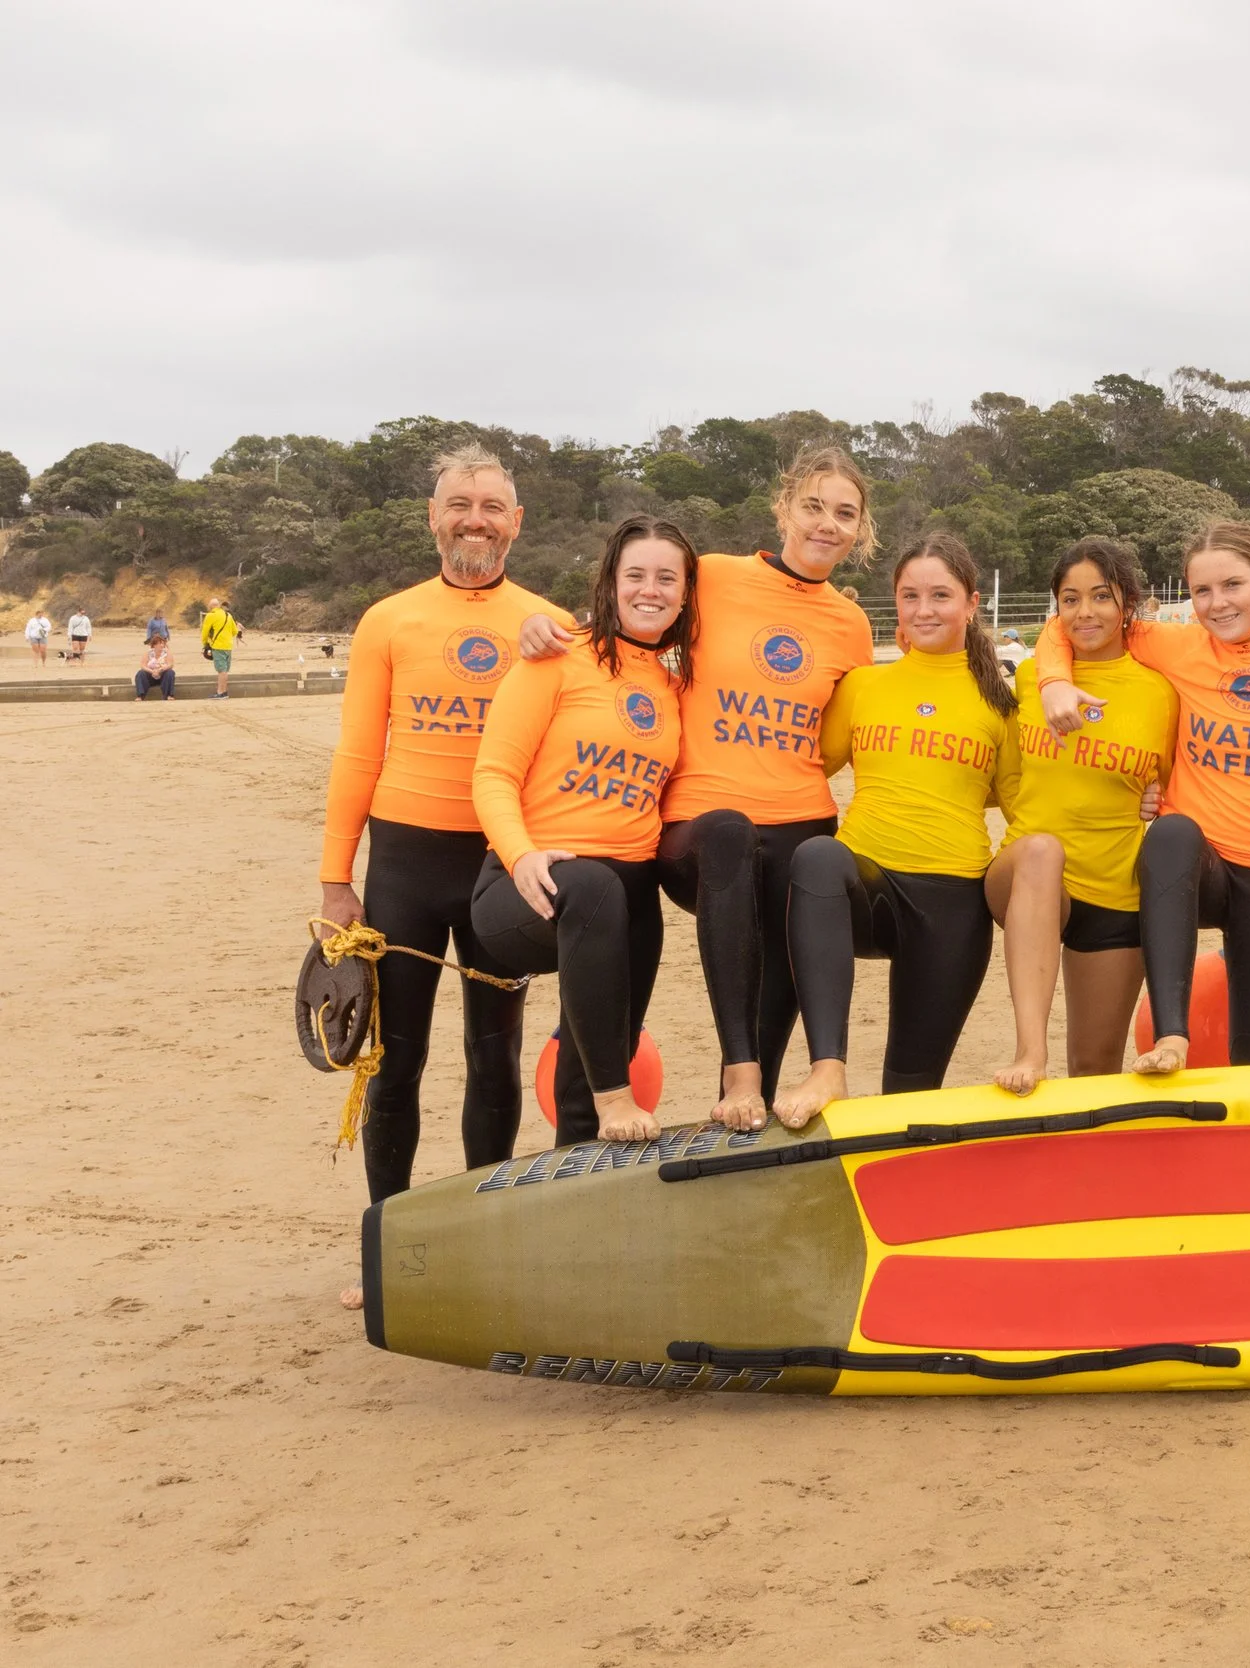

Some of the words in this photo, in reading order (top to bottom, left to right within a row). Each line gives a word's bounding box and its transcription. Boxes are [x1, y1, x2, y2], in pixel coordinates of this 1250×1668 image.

[459, 628, 498, 640] TORQUAY
[767, 627, 804, 642] TORQUAY
[408, 695, 493, 720] WAT
[716, 688, 820, 730] WATER
[713, 718, 816, 759] SAFETY
[853, 724, 902, 753] SURF
[909, 728, 995, 774] RESCUE
[1020, 723, 1068, 760] SURF
[576, 740, 671, 788] WATER
[558, 769, 658, 812] SAFETY
[487, 1352, 784, 1391] BENNETT
